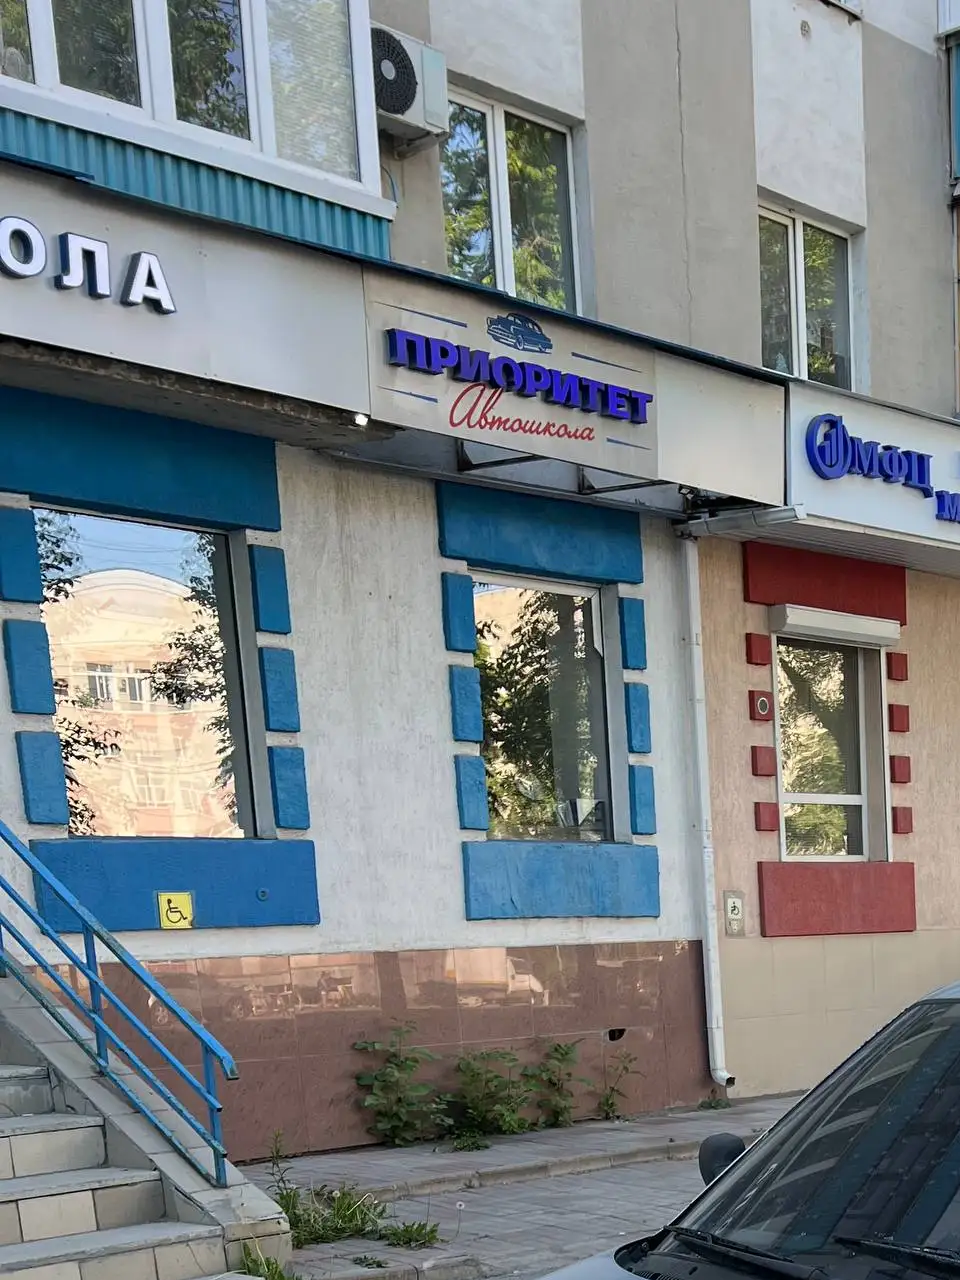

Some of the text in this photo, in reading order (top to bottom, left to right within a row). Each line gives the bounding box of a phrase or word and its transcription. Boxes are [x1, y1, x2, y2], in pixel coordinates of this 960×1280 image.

[0, 216, 176, 314] ОЛА
[385, 328, 653, 424] ПРИОРИТЕТ
[450, 382, 595, 441] Автошкола
